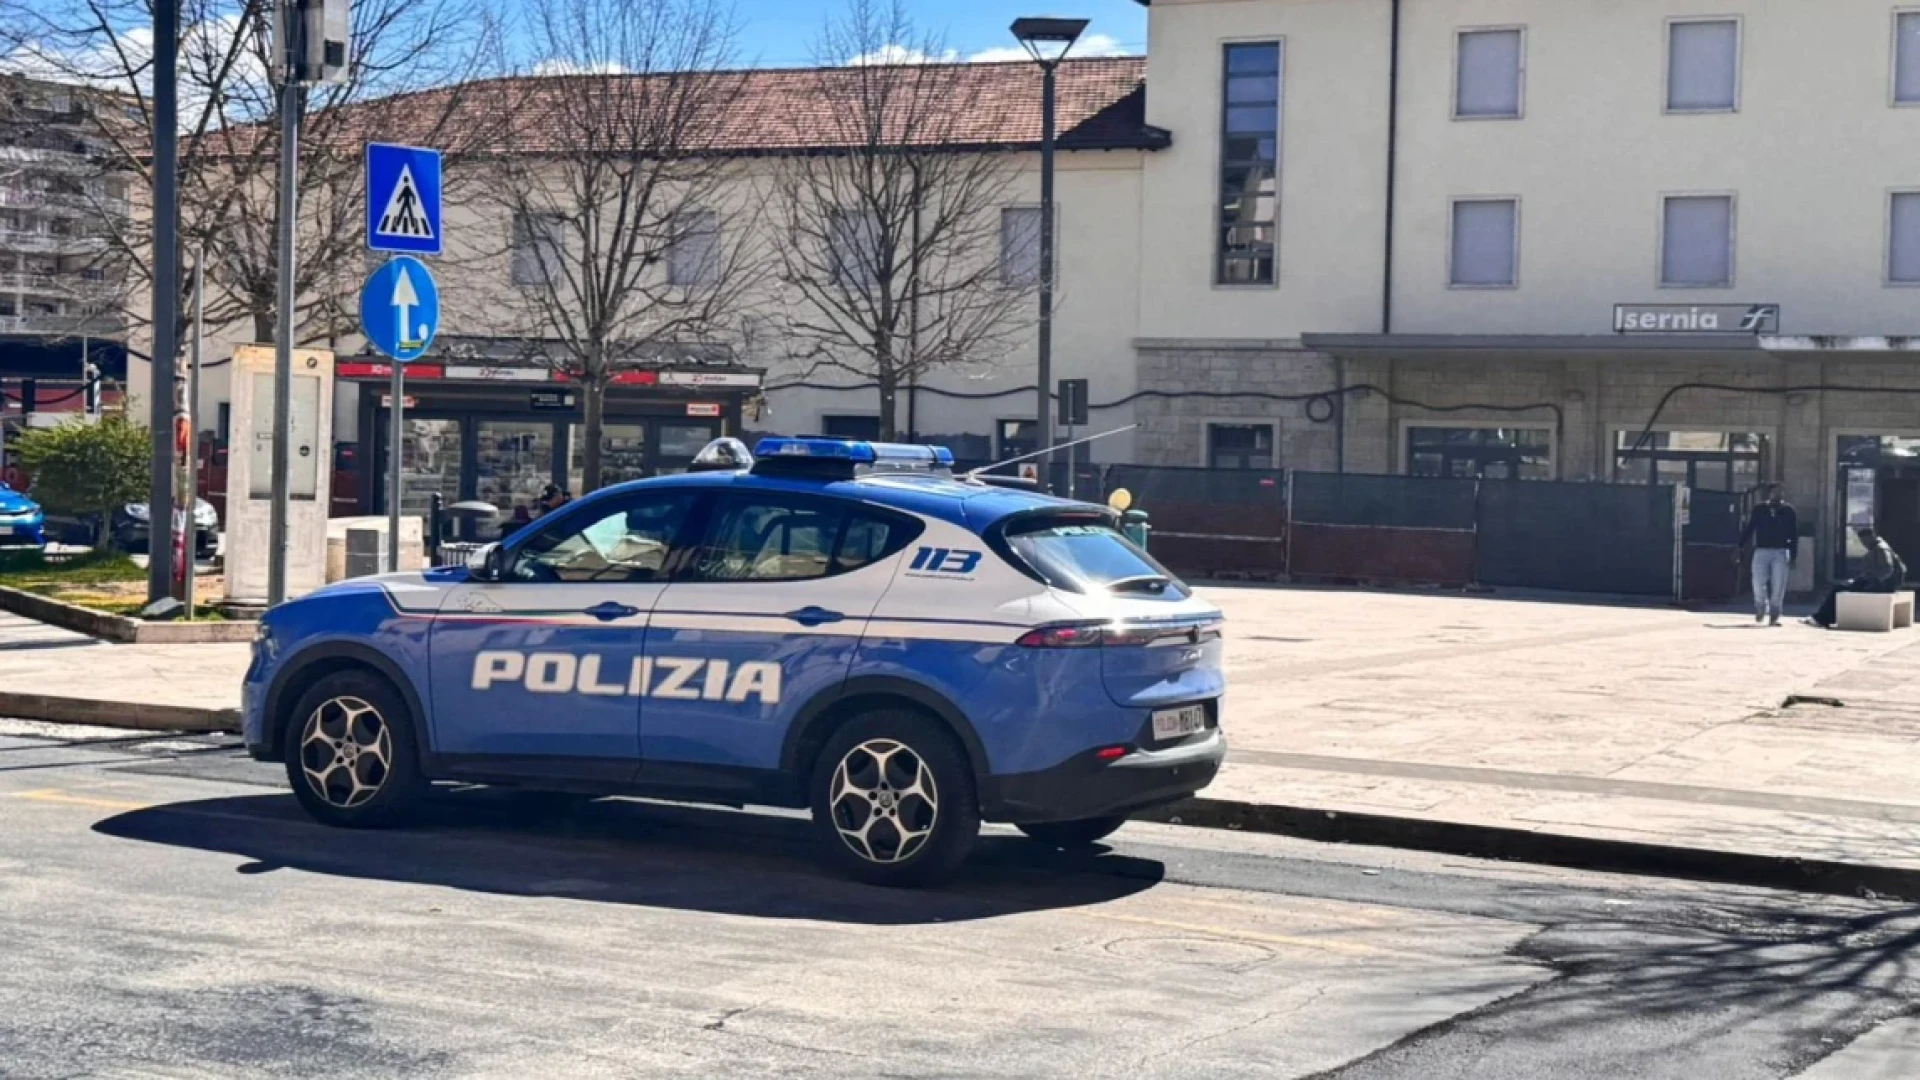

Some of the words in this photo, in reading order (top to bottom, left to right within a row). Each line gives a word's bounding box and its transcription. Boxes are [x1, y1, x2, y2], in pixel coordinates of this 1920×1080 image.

[1615, 306, 1718, 329] Isernia
[908, 547, 982, 573] 113
[471, 650, 782, 704] POLIZIA
